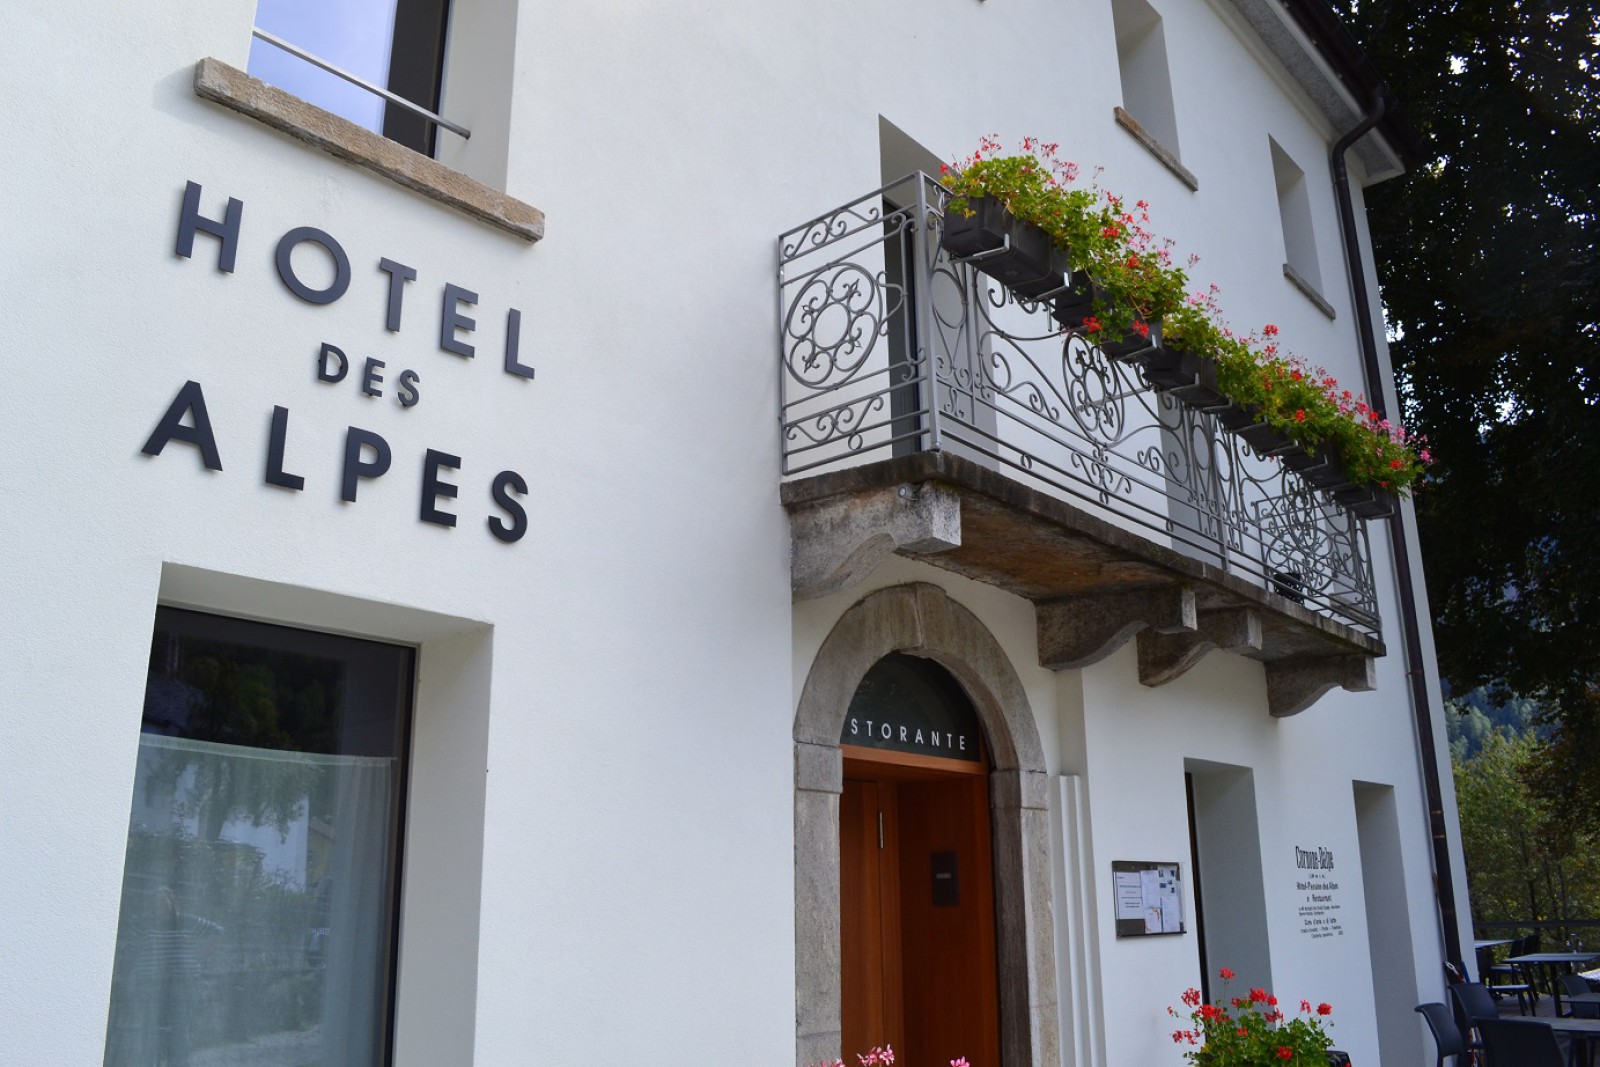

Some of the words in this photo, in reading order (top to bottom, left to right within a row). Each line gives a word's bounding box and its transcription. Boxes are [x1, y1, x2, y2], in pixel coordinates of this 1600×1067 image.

[175, 180, 535, 380] HOTEL
[317, 342, 420, 408] DES
[141, 380, 529, 543] ALPES
